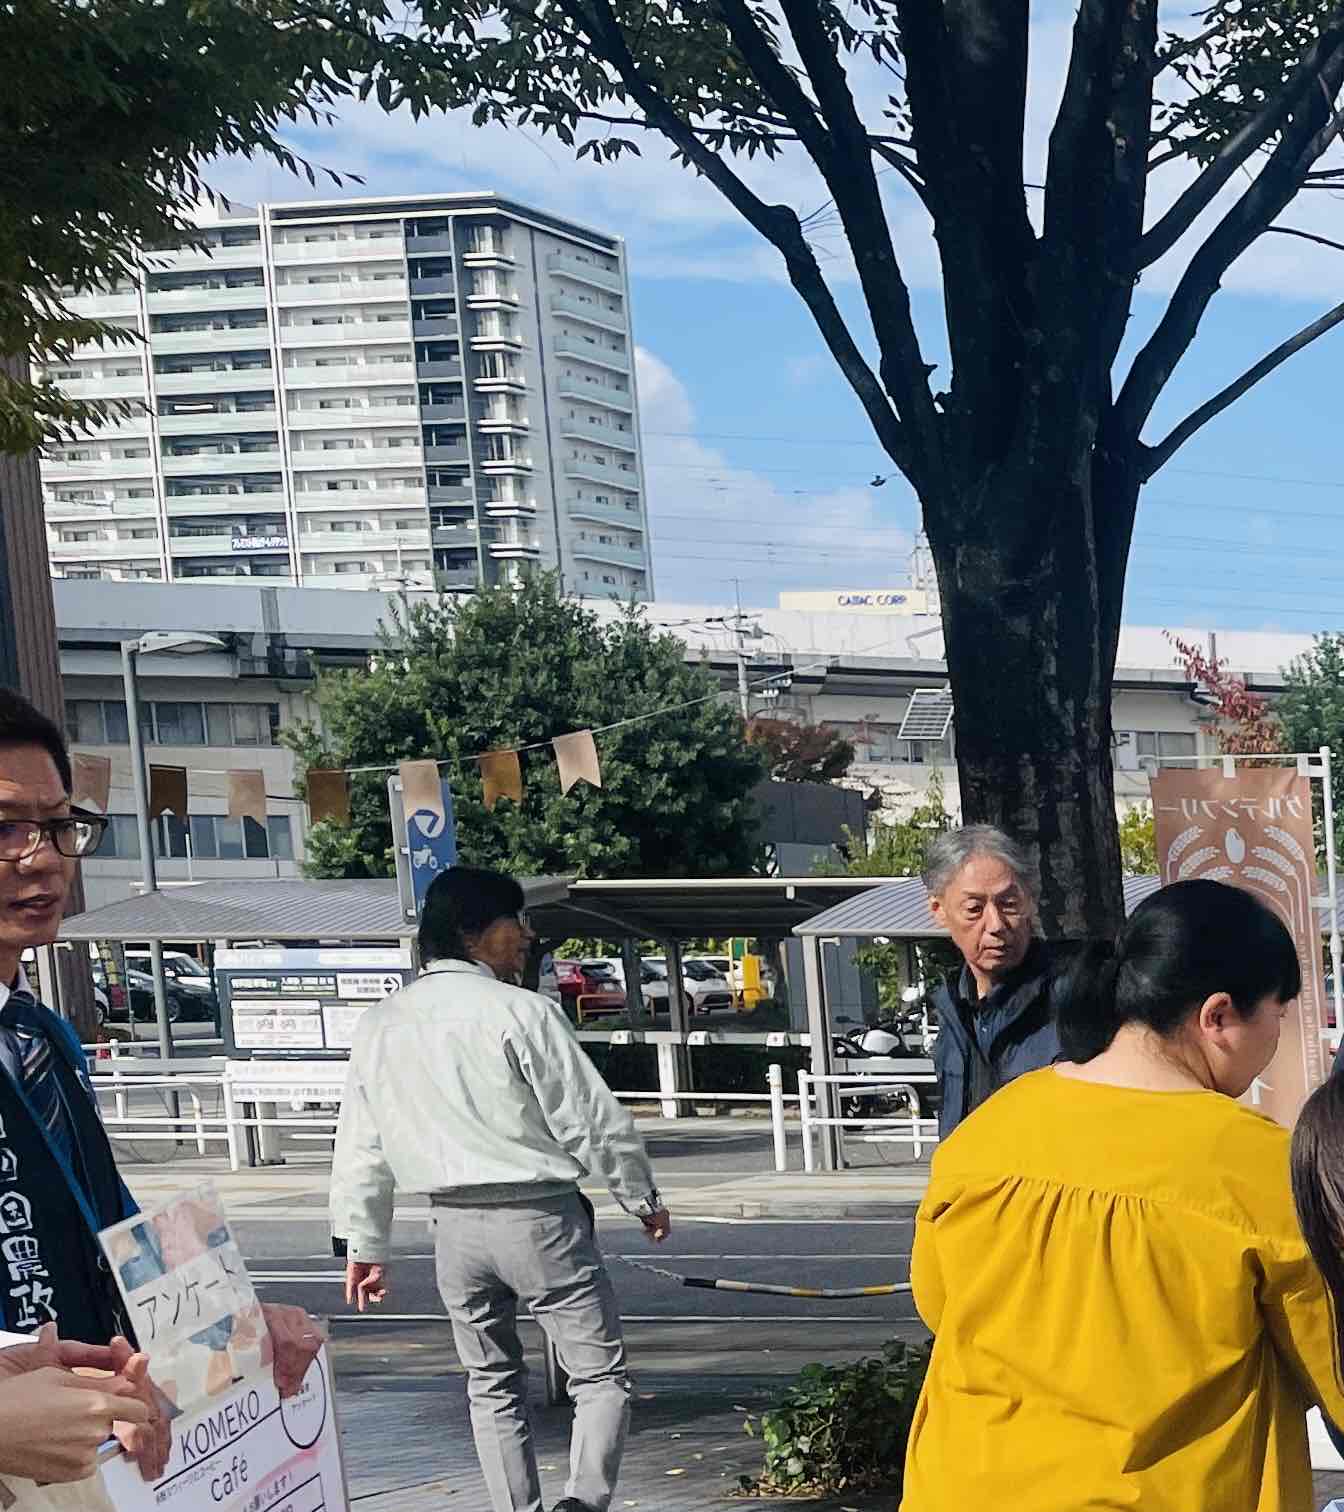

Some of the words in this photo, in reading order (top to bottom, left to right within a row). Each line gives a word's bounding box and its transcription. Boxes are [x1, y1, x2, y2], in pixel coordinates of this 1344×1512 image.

[136, 1250, 239, 1340] アンケート
[179, 1390, 260, 1464] KOMEKO
